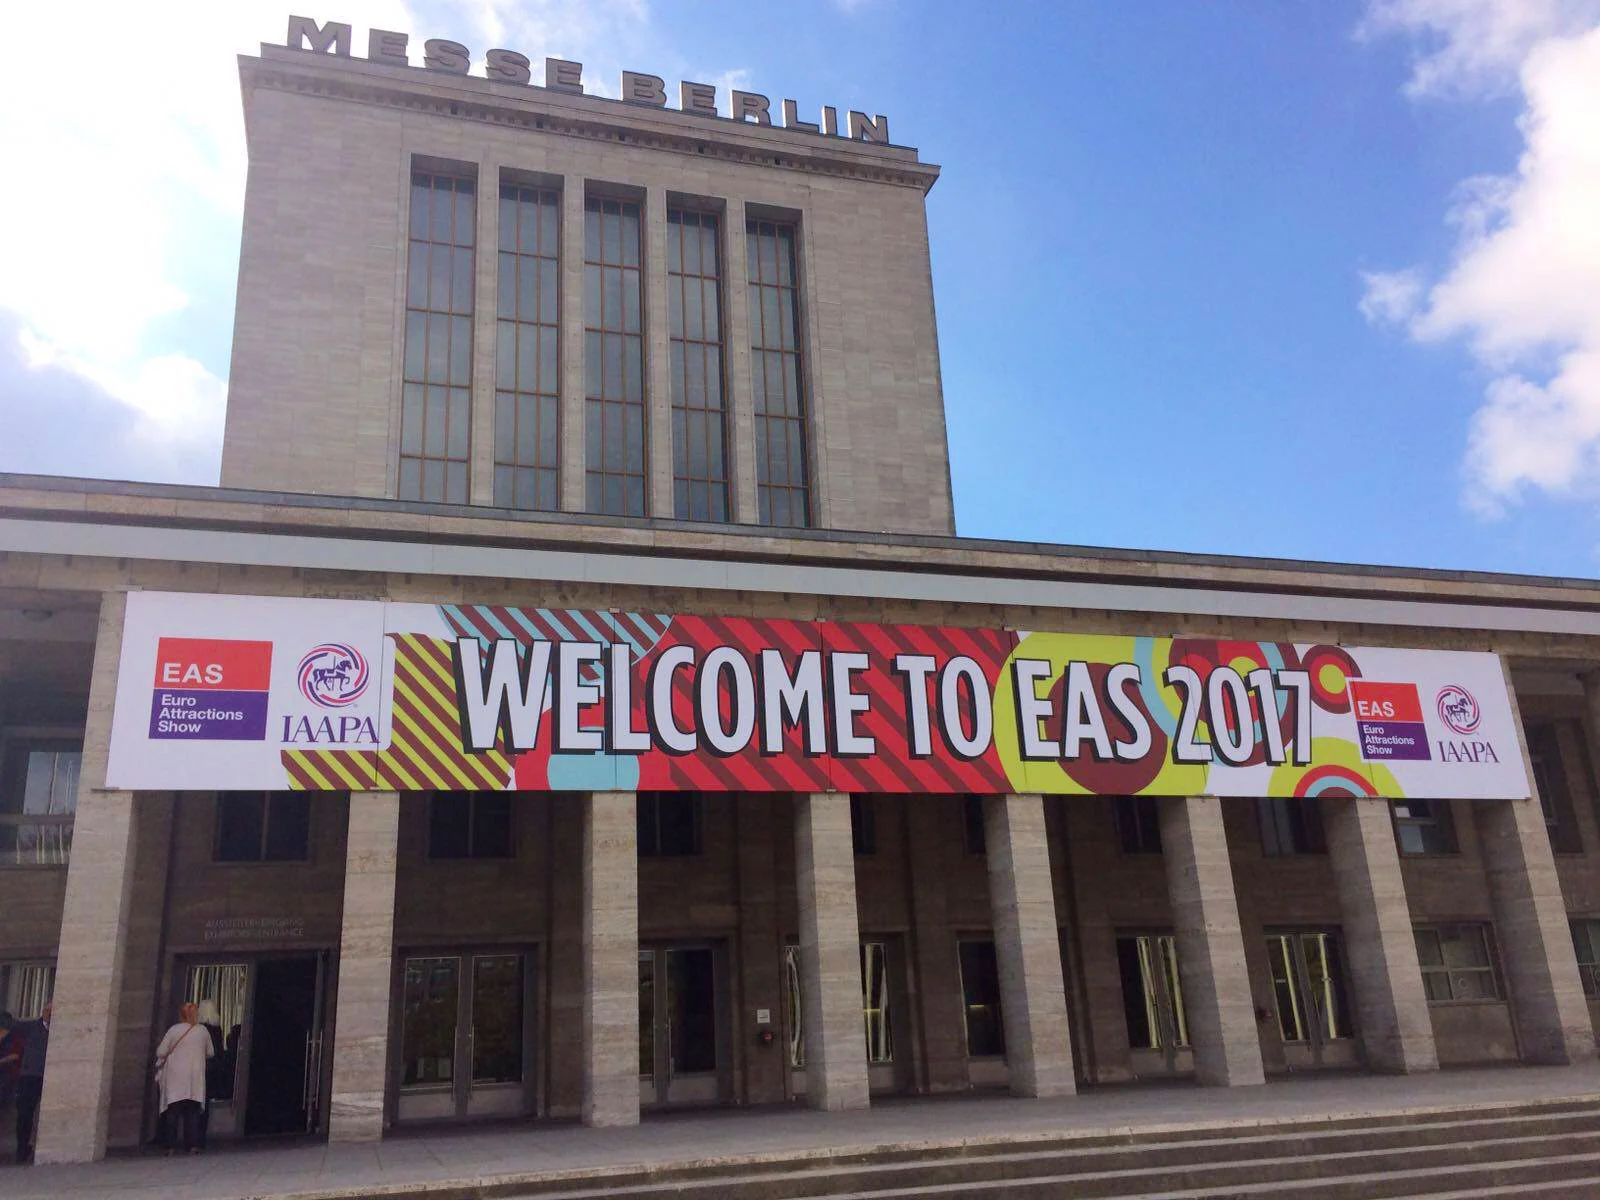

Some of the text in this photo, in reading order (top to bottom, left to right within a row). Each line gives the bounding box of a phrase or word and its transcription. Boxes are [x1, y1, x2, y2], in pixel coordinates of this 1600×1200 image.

[288, 15, 890, 145] MESSE BERLIN
[162, 663, 224, 684] EAS
[160, 693, 197, 707] Euro
[452, 637, 1312, 767] WELCOME TO EAS 2017
[158, 707, 244, 721] Attractions
[1359, 701, 1395, 717] EAS
[157, 720, 202, 733] Show
[280, 715, 381, 744] IAAPA
[1363, 724, 1385, 735] Euro
[1365, 735, 1415, 745] Attractions
[1367, 744, 1393, 755] Show
[1438, 742, 1499, 762] IAAPA
